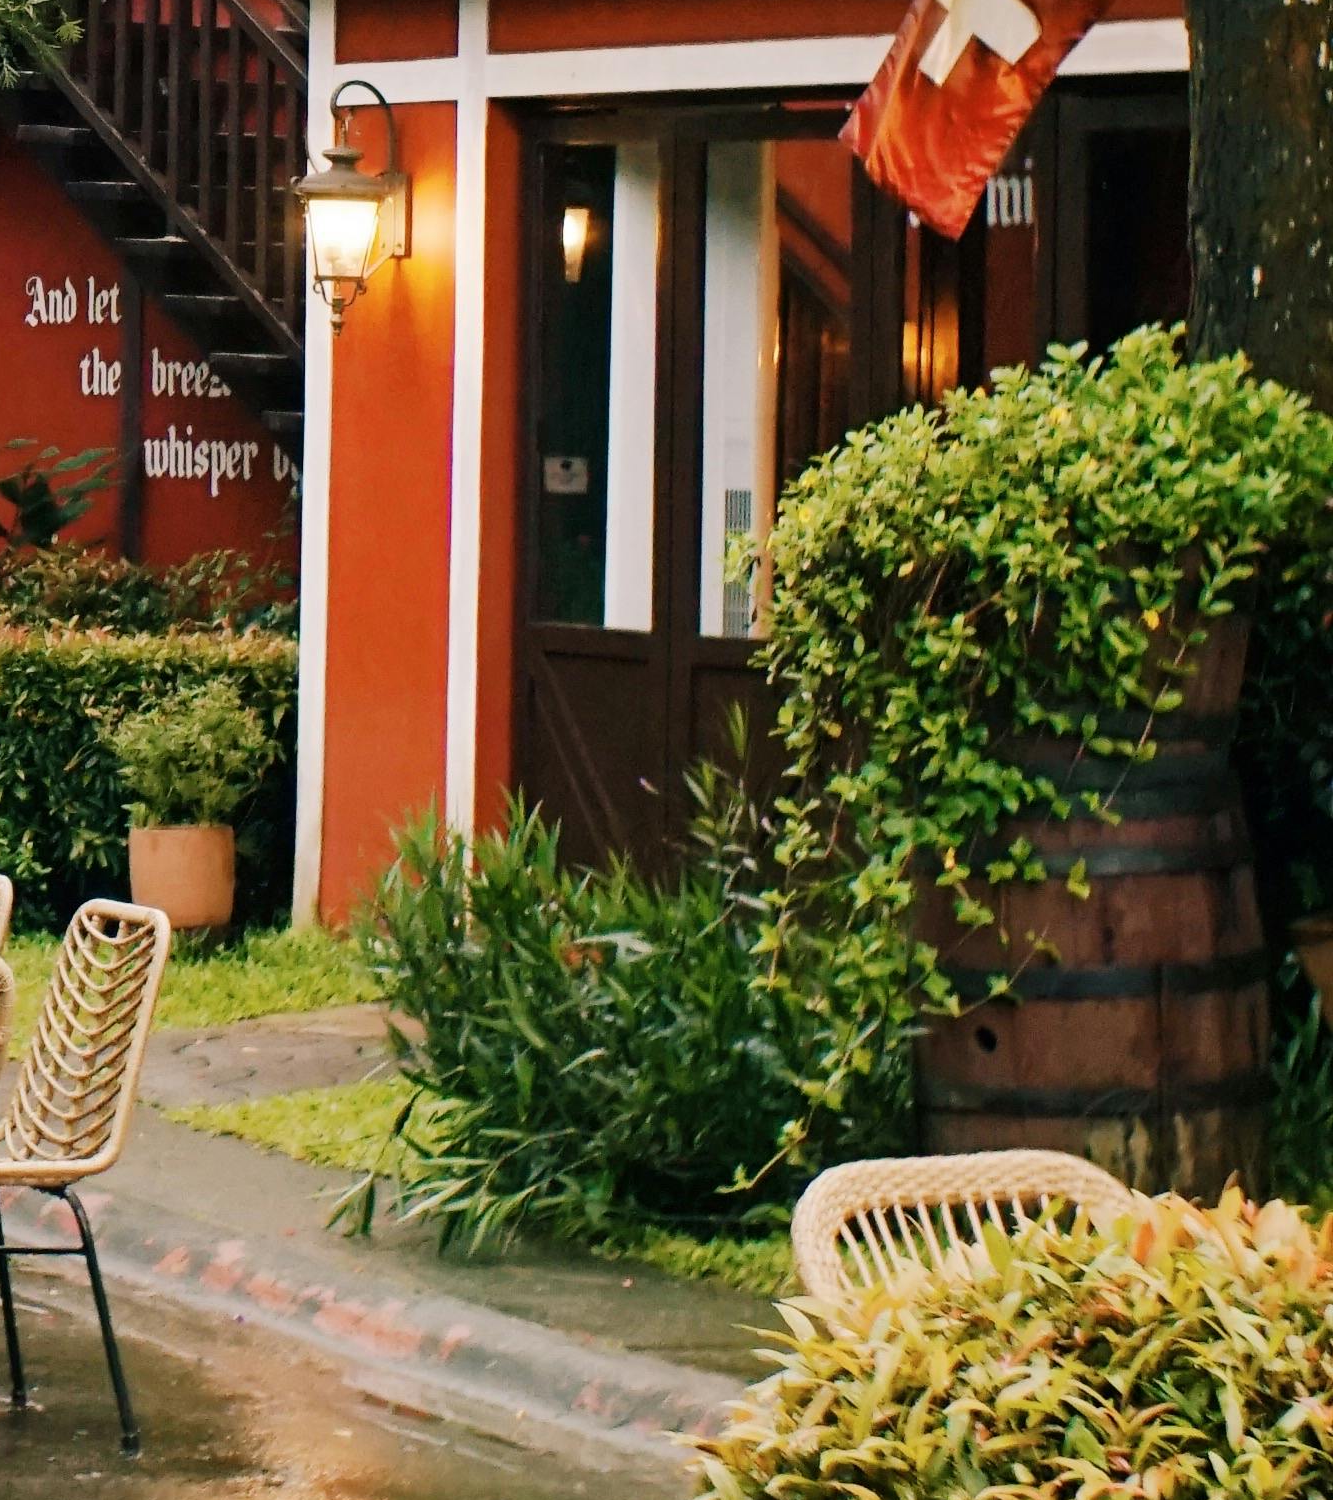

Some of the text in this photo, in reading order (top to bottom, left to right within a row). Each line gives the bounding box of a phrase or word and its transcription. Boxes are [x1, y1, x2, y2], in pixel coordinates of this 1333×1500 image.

[25, 275, 122, 328] And let
[79, 346, 122, 396] the
[144, 424, 259, 498] whisper
